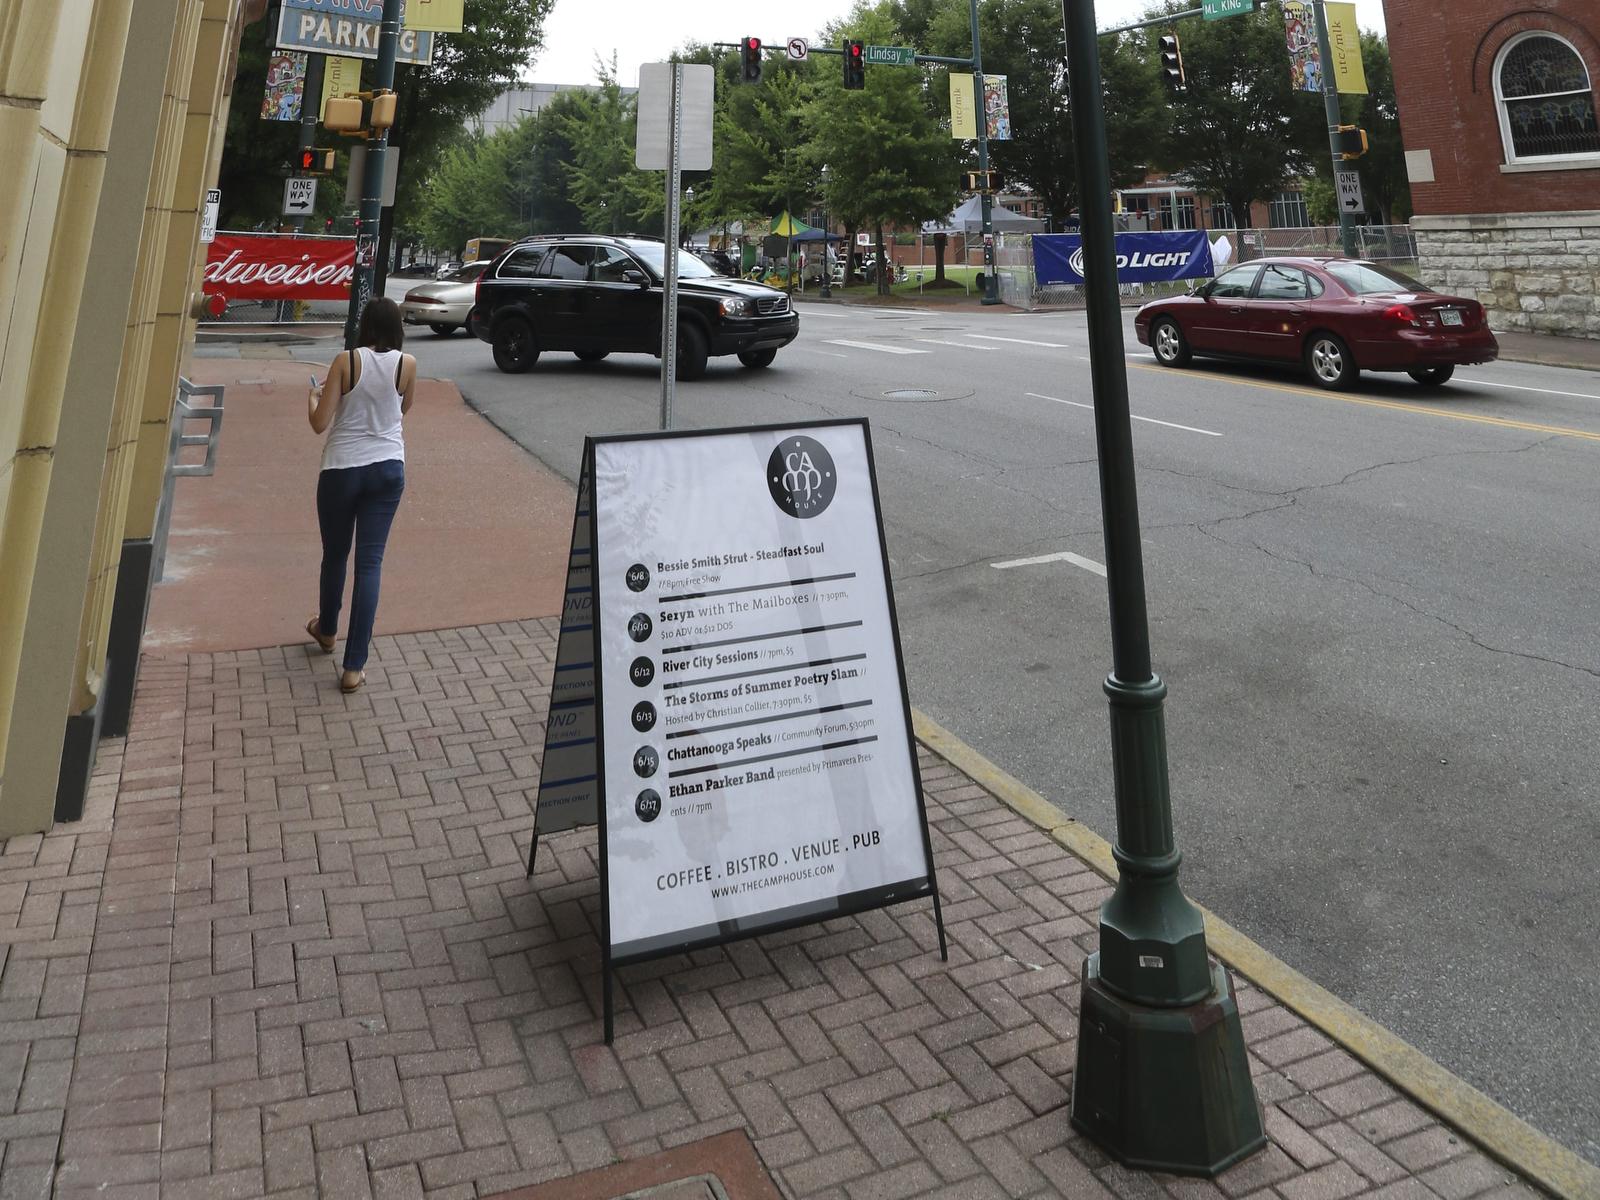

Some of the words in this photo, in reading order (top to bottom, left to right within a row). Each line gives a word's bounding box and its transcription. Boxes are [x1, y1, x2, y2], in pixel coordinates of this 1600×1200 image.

[301, 14, 416, 53] PARKIG
[869, 47, 901, 64] Lindsay
[1332, 21, 1347, 74] utc/mlk
[330, 58, 342, 98] tc/mlk
[292, 181, 312, 190] ONE
[1340, 173, 1357, 183] ONE
[290, 191, 312, 200] WAY
[1341, 184, 1358, 194] WAY
[786, 492, 823, 509] HOUSE
[657, 560, 689, 573] Bessie
[691, 557, 721, 569] Smith
[723, 552, 748, 565] Strut
[756, 546, 802, 561] Steadfast
[803, 542, 825, 555] Soul
[631, 571, 644, 581] 6/8
[685, 576, 701, 585] Free
[702, 574, 721, 584] Show
[660, 609, 694, 623] Seryn
[698, 602, 725, 617] with
[728, 601, 749, 614] The
[752, 593, 809, 610] Mailboxes
[820, 590, 849, 602] 7:30pm,
[631, 623, 648, 632] 6/10
[661, 629, 674, 640] $10
[675, 628, 693, 638] ADV
[704, 624, 715, 633] $12
[717, 621, 733, 631] DOS
[662, 660, 690, 673] River
[692, 656, 713, 670] City
[716, 649, 759, 664] Sessions
[786, 646, 794, 655] $5
[634, 667, 650, 677] 6/12
[554, 681, 586, 690] RECTION
[665, 695, 687, 707] The
[689, 689, 729, 704] Storms
[731, 684, 743, 697] of
[745, 679, 792, 694] Summer
[794, 672, 829, 687] Poetry
[831, 667, 858, 681] Slam
[636, 712, 653, 723] 6/13
[665, 712, 694, 726] Hosted
[695, 711, 705, 723] by
[707, 705, 743, 719] Christian
[745, 701, 772, 713] Collier,
[772, 696, 803, 710] 7:30pm,
[804, 694, 812, 703] $5
[667, 738, 734, 761] Chattanooga
[736, 733, 772, 749] Speaks
[781, 727, 823, 742] Community
[824, 723, 849, 736] Forum,
[849, 718, 875, 732] 5:30pm
[638, 756, 655, 767] 6/15
[669, 783, 703, 798] Ethan
[705, 775, 744, 790] Parker
[746, 767, 775, 783] Band
[777, 764, 811, 779] presented
[812, 762, 821, 773] by
[822, 756, 857, 770] Primavera
[857, 753, 874, 764] Pres-
[539, 798, 570, 809] RECTION
[571, 793, 590, 803] ONLY
[640, 800, 657, 811] 6/17
[670, 805, 686, 817] ents
[696, 802, 712, 815] 7pm
[657, 865, 713, 891] COFFEE
[726, 851, 779, 877] BISTRO
[792, 838, 840, 862] VENUE
[852, 830, 881, 849] PUB
[711, 863, 835, 899] WWW.THECAMPHOUSE.COM
